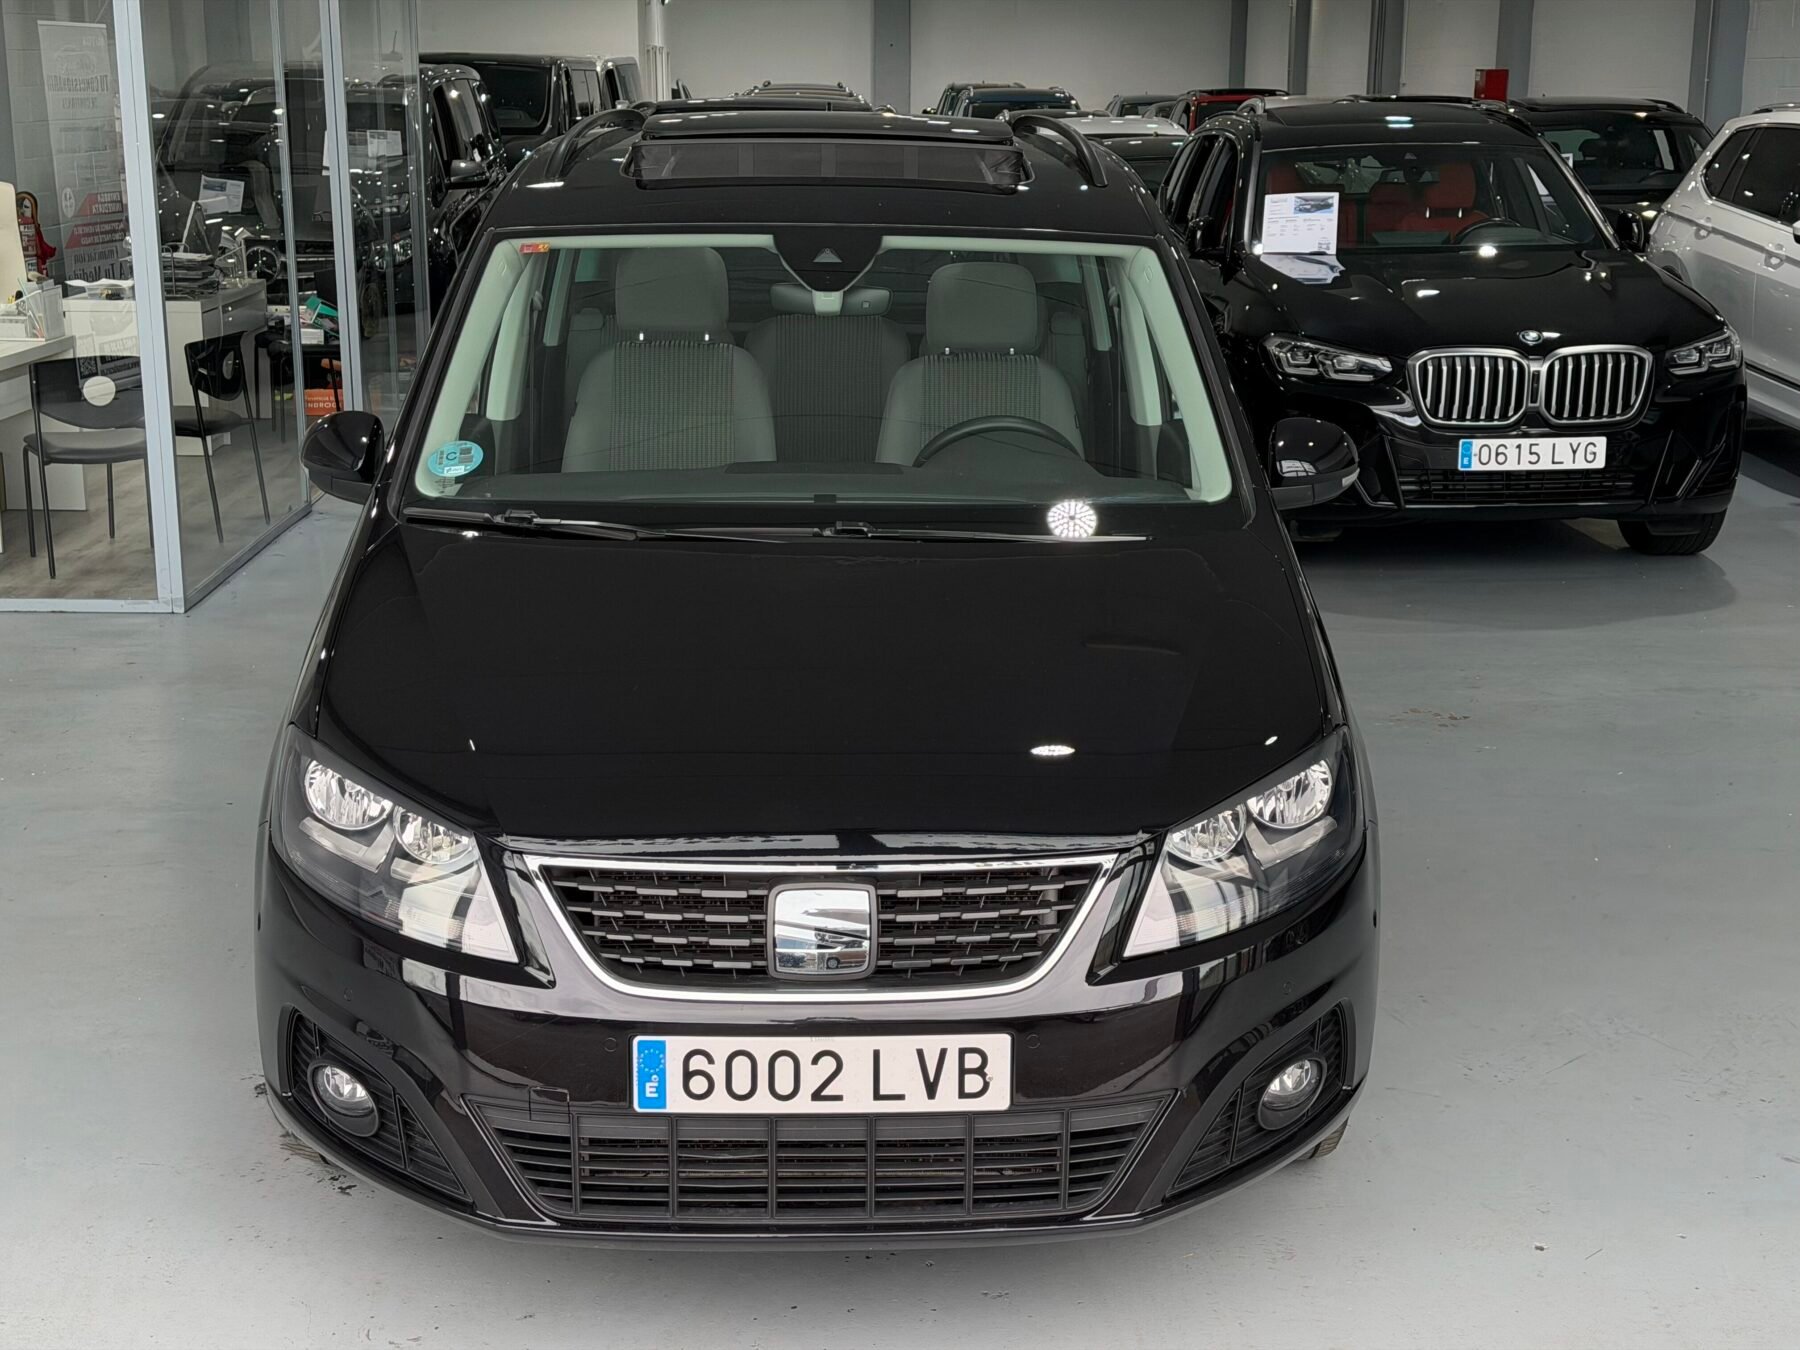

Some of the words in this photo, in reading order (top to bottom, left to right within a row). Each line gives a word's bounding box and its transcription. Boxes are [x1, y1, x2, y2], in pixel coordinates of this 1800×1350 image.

[446, 451, 457, 461] C
[1478, 443, 1541, 465] 0615
[1551, 442, 1598, 465] LYG
[645, 1082, 659, 1098] E
[682, 1048, 844, 1102] 6002
[872, 1047, 993, 1102] LVB
